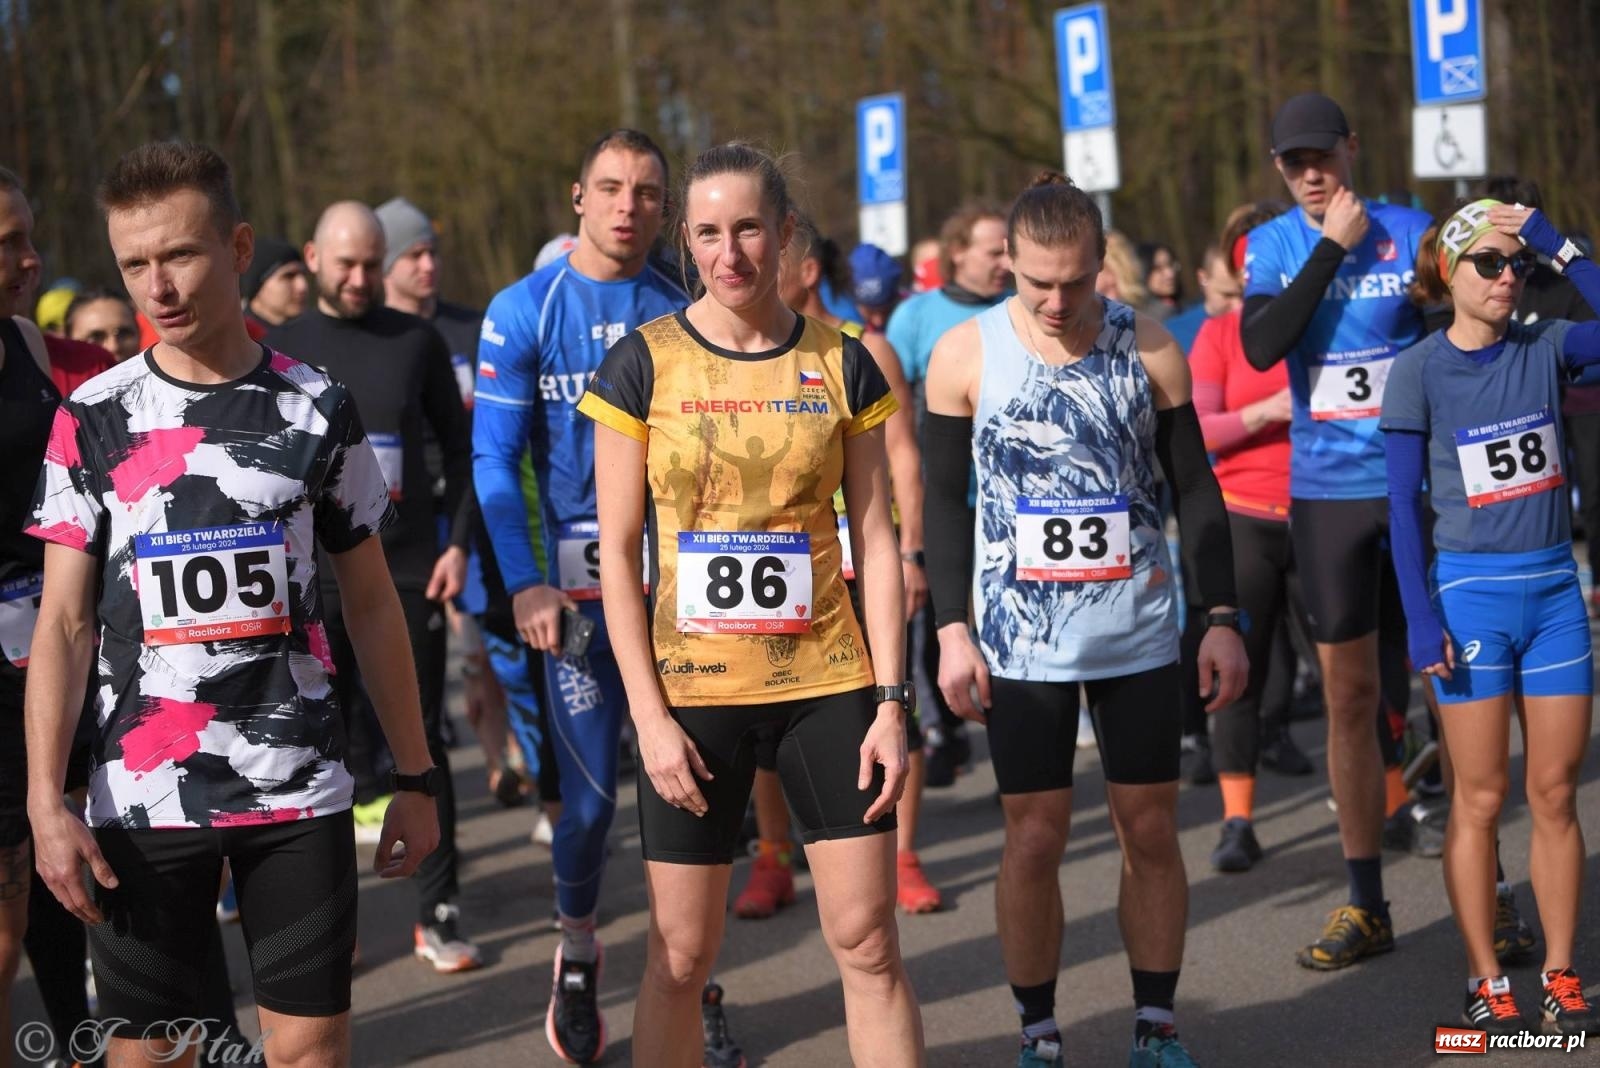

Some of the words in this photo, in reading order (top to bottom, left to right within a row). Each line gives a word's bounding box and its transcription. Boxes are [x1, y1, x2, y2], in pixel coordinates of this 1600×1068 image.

[1425, 0, 1468, 62] P
[1065, 16, 1100, 98] P
[864, 105, 896, 176] P
[1280, 270, 1416, 299] NERS
[539, 371, 596, 404] RU
[1345, 366, 1372, 402] 3
[681, 400, 765, 414] ENERGY
[772, 400, 829, 415] TEAM
[1480, 424, 1499, 435] BIEG
[1499, 411, 1544, 429] TWARDZIELA
[1485, 432, 1547, 481] 58
[1029, 499, 1040, 508] XII
[1041, 499, 1061, 508] BIEG
[1062, 497, 1117, 508] TWARDZIELA
[151, 537, 163, 547] XII
[166, 533, 192, 545] BIEG
[195, 526, 266, 541] TWARDZIELA
[192, 541, 217, 551] lutego
[218, 539, 237, 548] 2024
[693, 534, 705, 543] XII
[707, 534, 729, 543] BIEG
[731, 534, 796, 544] TWARDZIELA
[730, 544, 752, 552] lutego
[1043, 516, 1108, 561] 83
[151, 550, 276, 618] 105
[706, 555, 788, 609] 86
[188, 626, 232, 638] Racibórz
[718, 621, 757, 630] Racibórz
[765, 676, 801, 688] BOLATICE
[772, 669, 793, 678] OBEC
